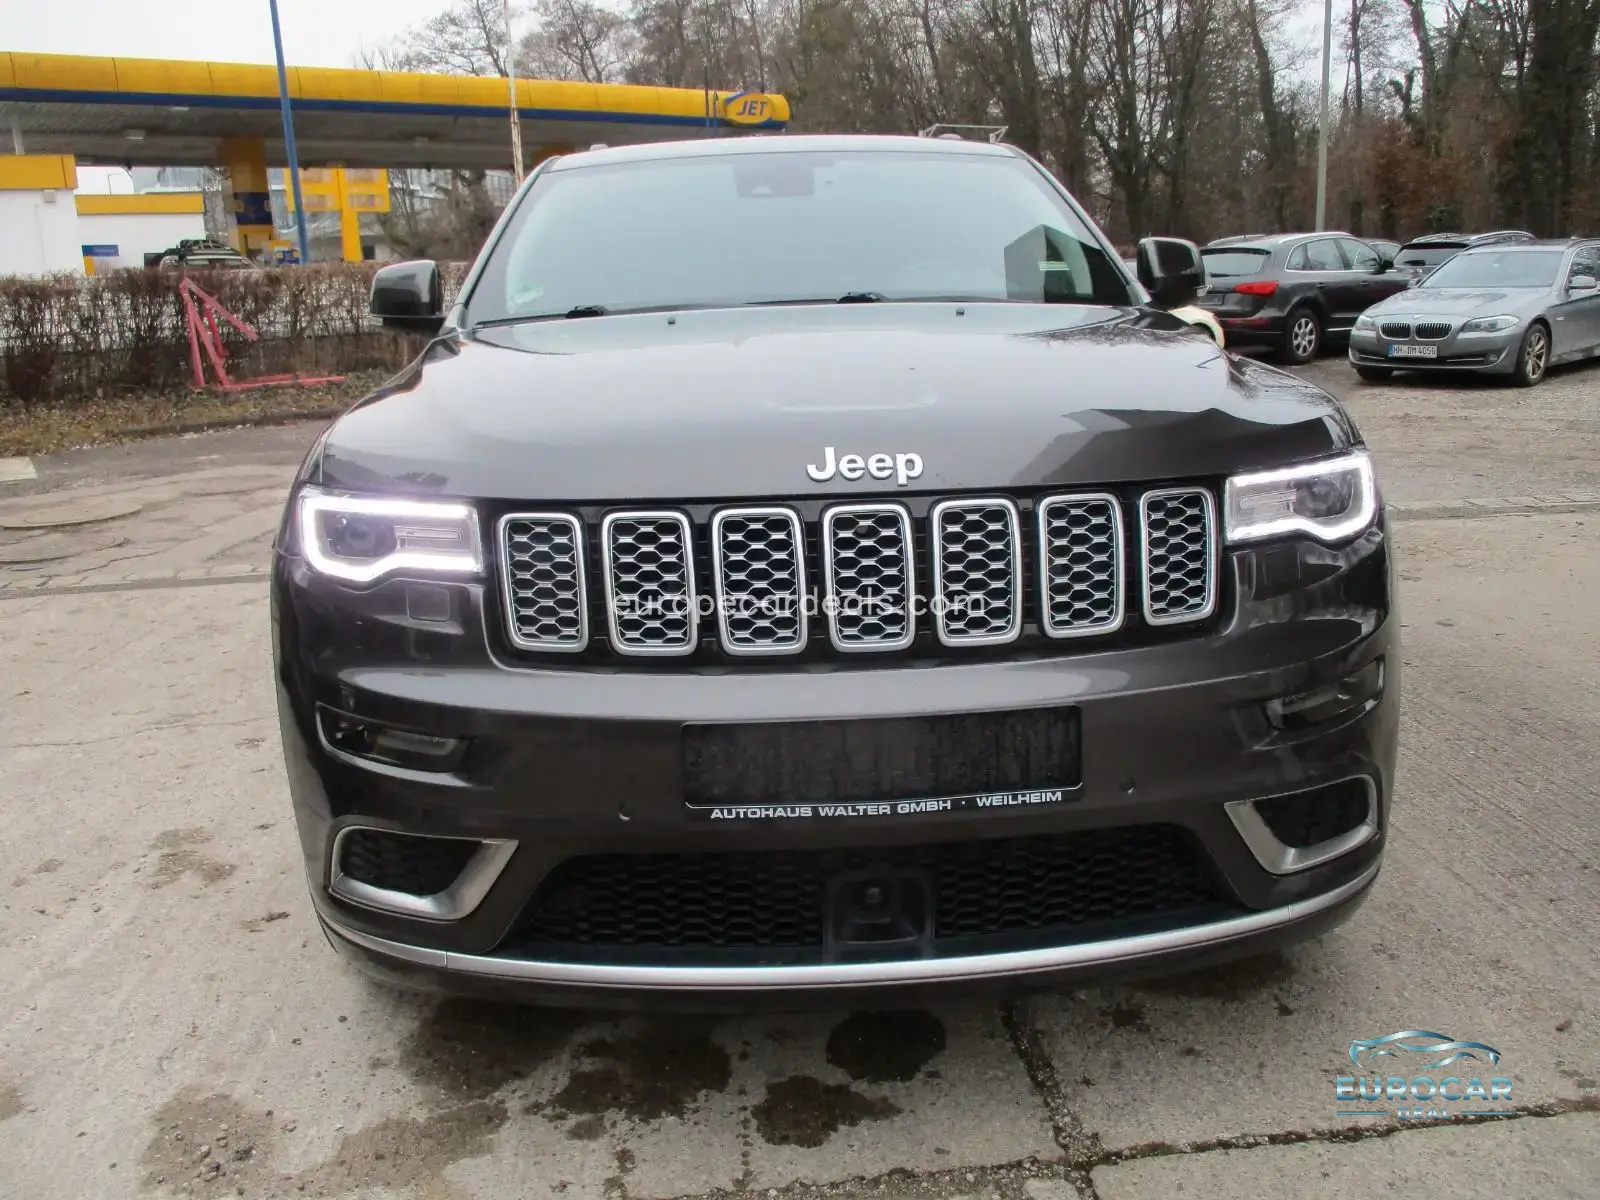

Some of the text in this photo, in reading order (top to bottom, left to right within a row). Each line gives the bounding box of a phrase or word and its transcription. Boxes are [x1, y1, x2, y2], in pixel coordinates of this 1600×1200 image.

[736, 100, 768, 116] JET
[806, 446, 924, 486] Jeep
[710, 791, 1063, 820] AUTOHAUS WALTER GMBH WEILHEIM
